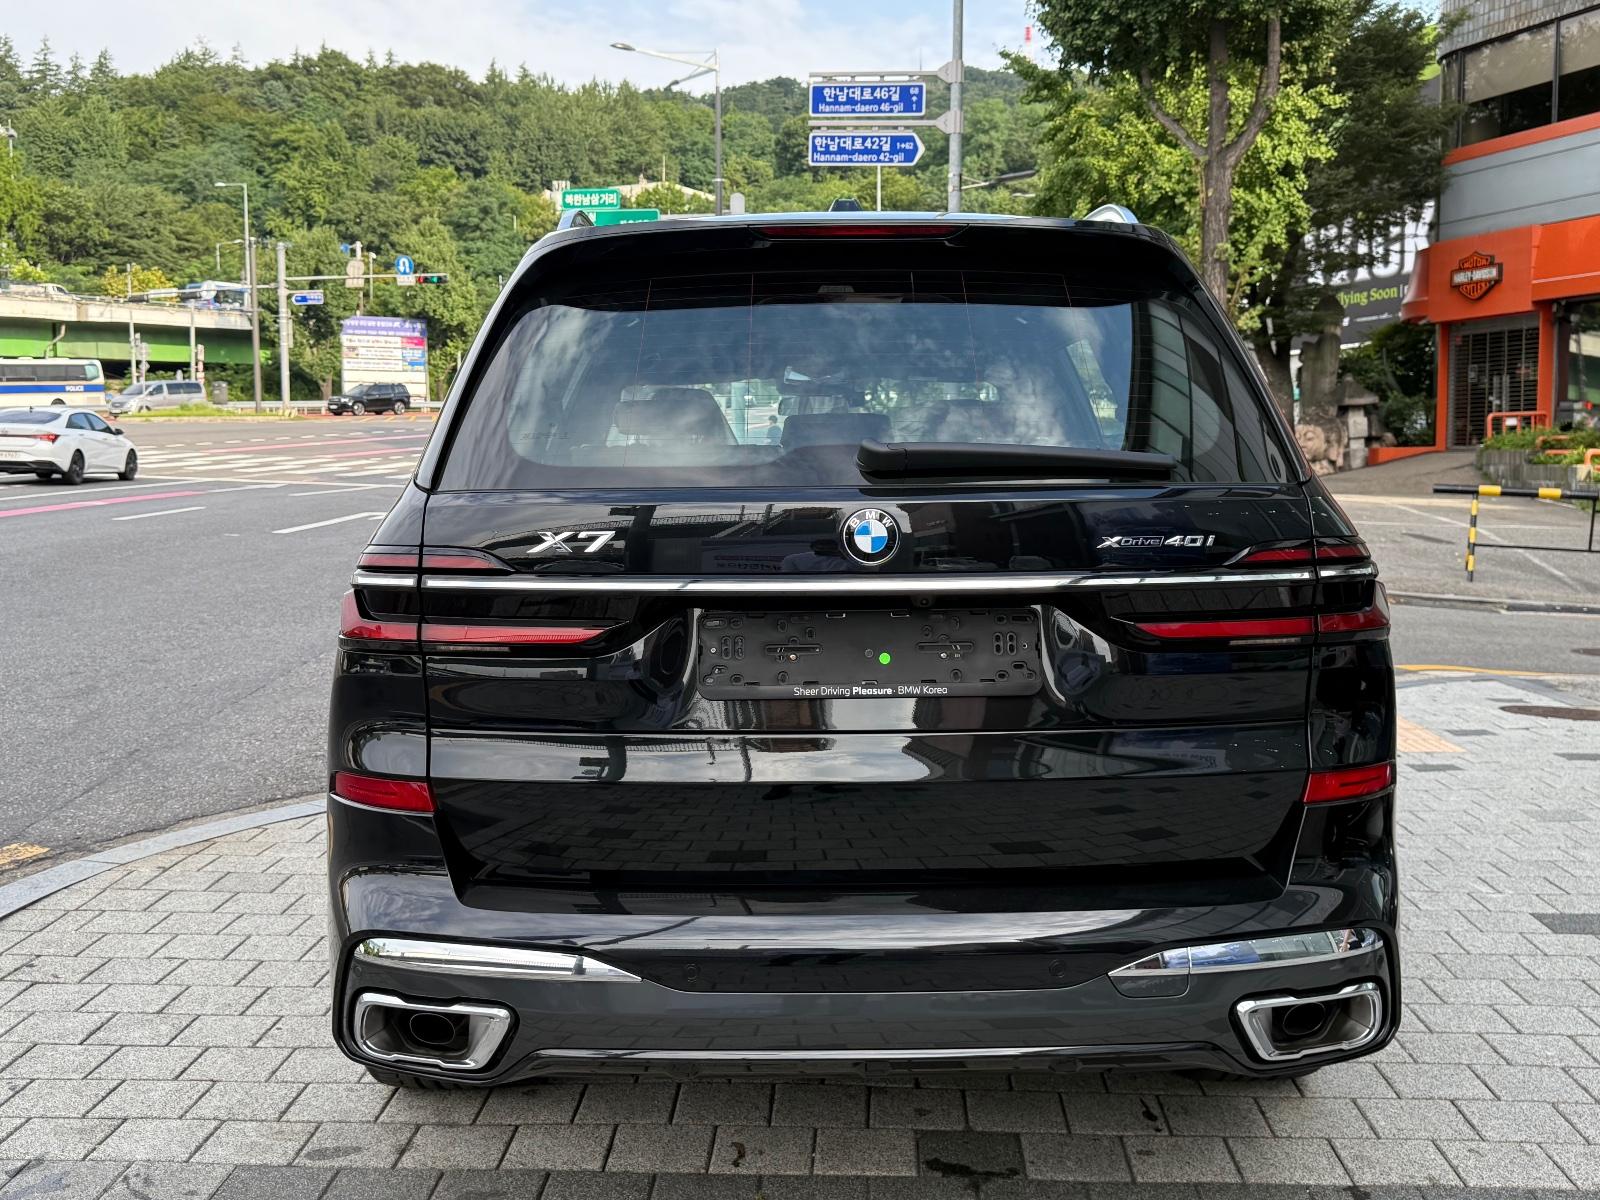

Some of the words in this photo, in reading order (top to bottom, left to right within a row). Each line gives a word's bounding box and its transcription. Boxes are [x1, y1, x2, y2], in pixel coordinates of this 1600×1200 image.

[823, 86, 900, 101] 한남대로46길
[819, 103, 879, 112] Hannam-daero
[880, 103, 904, 113] 46-gil
[814, 136, 891, 151] 한남대로42길
[813, 152, 877, 161] Hannam-daero
[879, 152, 904, 162] 42-gil
[1370, 287, 1398, 301] Soon
[849, 511, 893, 528] BMW
[526, 531, 616, 553] X7
[793, 686, 819, 696] Sheer
[820, 686, 851, 697] Driving
[897, 685, 921, 695] BMW
[922, 685, 948, 694] Korea
